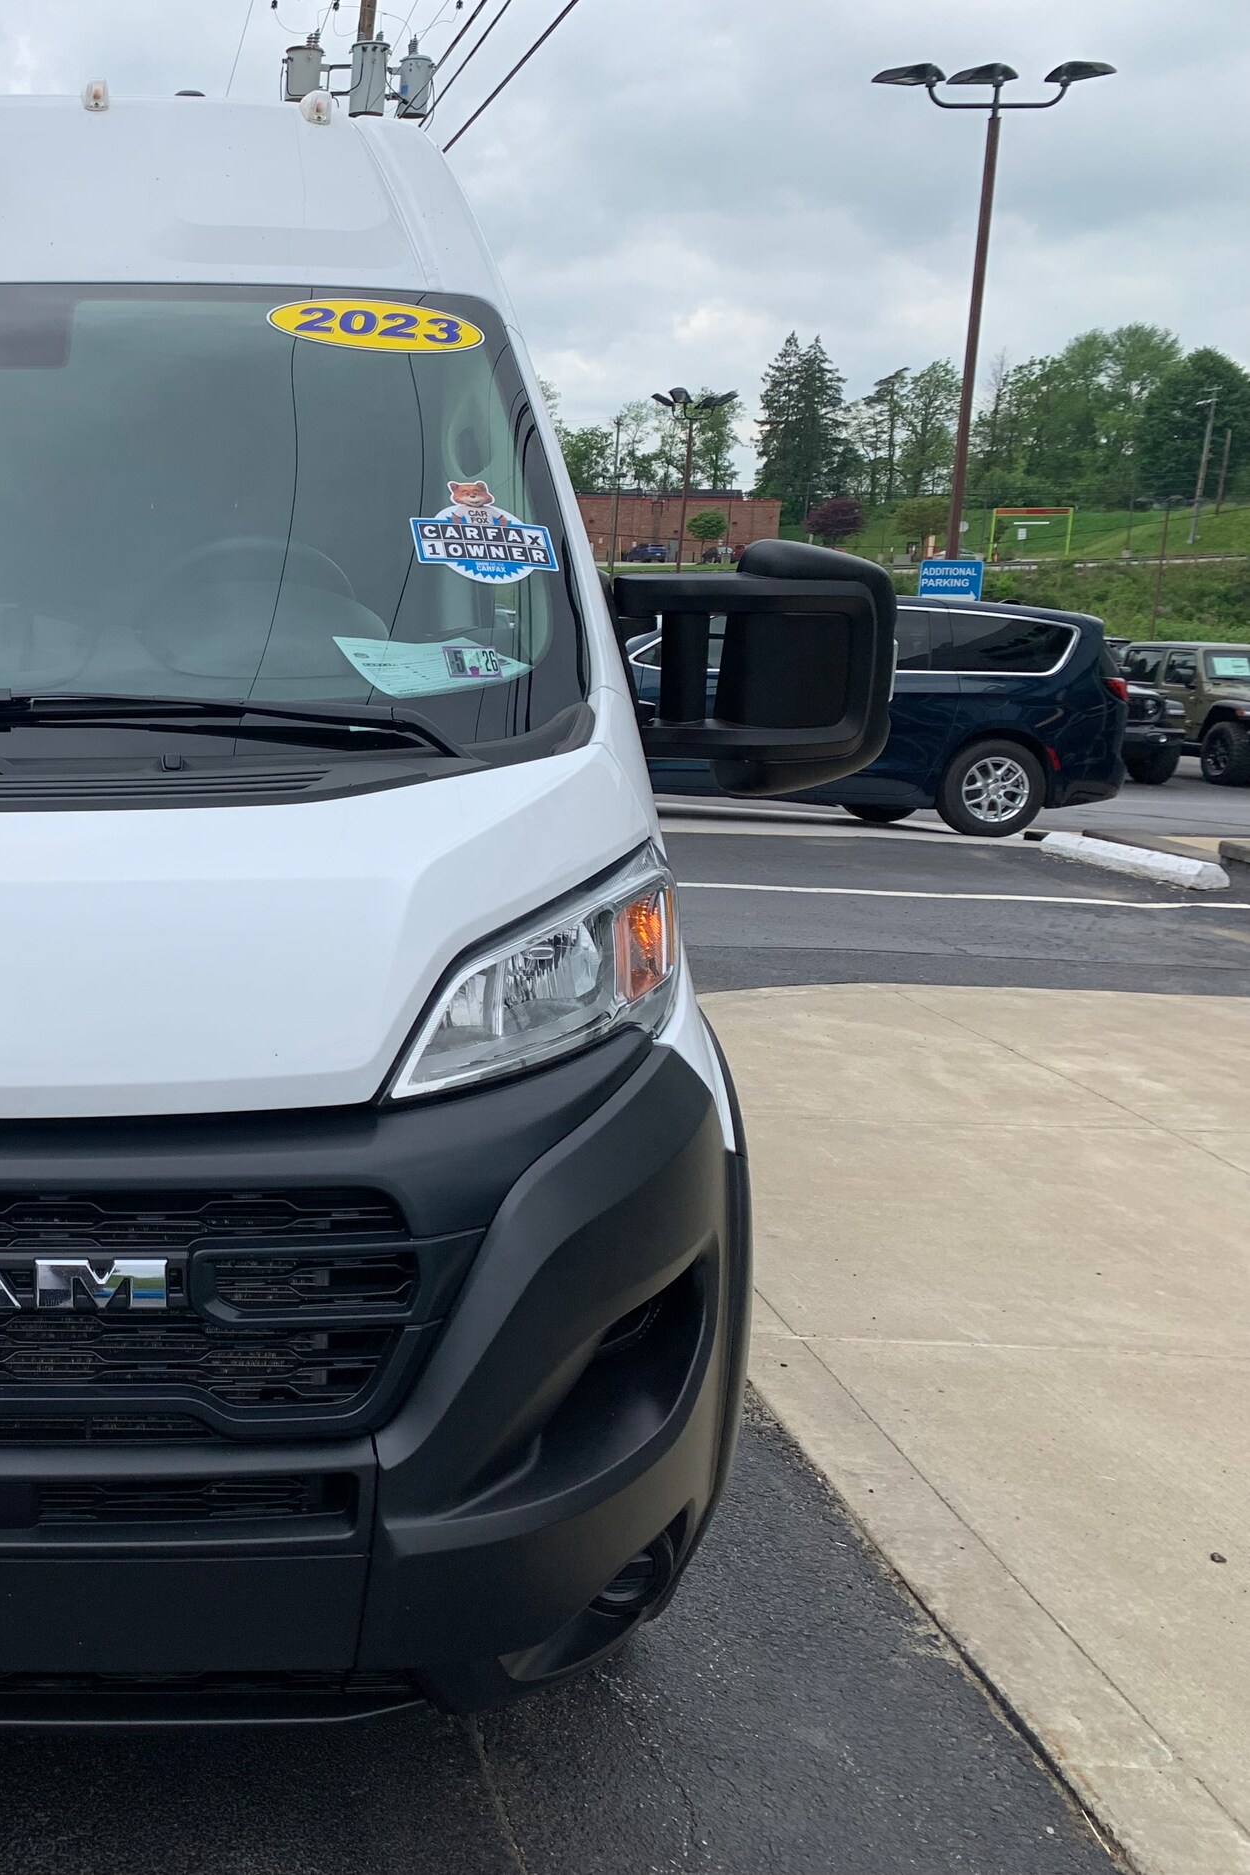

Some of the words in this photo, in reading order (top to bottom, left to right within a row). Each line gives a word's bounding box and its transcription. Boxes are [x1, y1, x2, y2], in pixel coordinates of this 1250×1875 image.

[294, 307, 462, 344] 2023
[423, 525, 543, 546] CARFAX
[427, 543, 441, 556] 1
[448, 544, 546, 563] OWNER
[476, 565, 507, 573] CARFAX
[922, 567, 978, 576] ADDITIONAL
[921, 578, 970, 587] PARKING
[482, 650, 499, 672] 26
